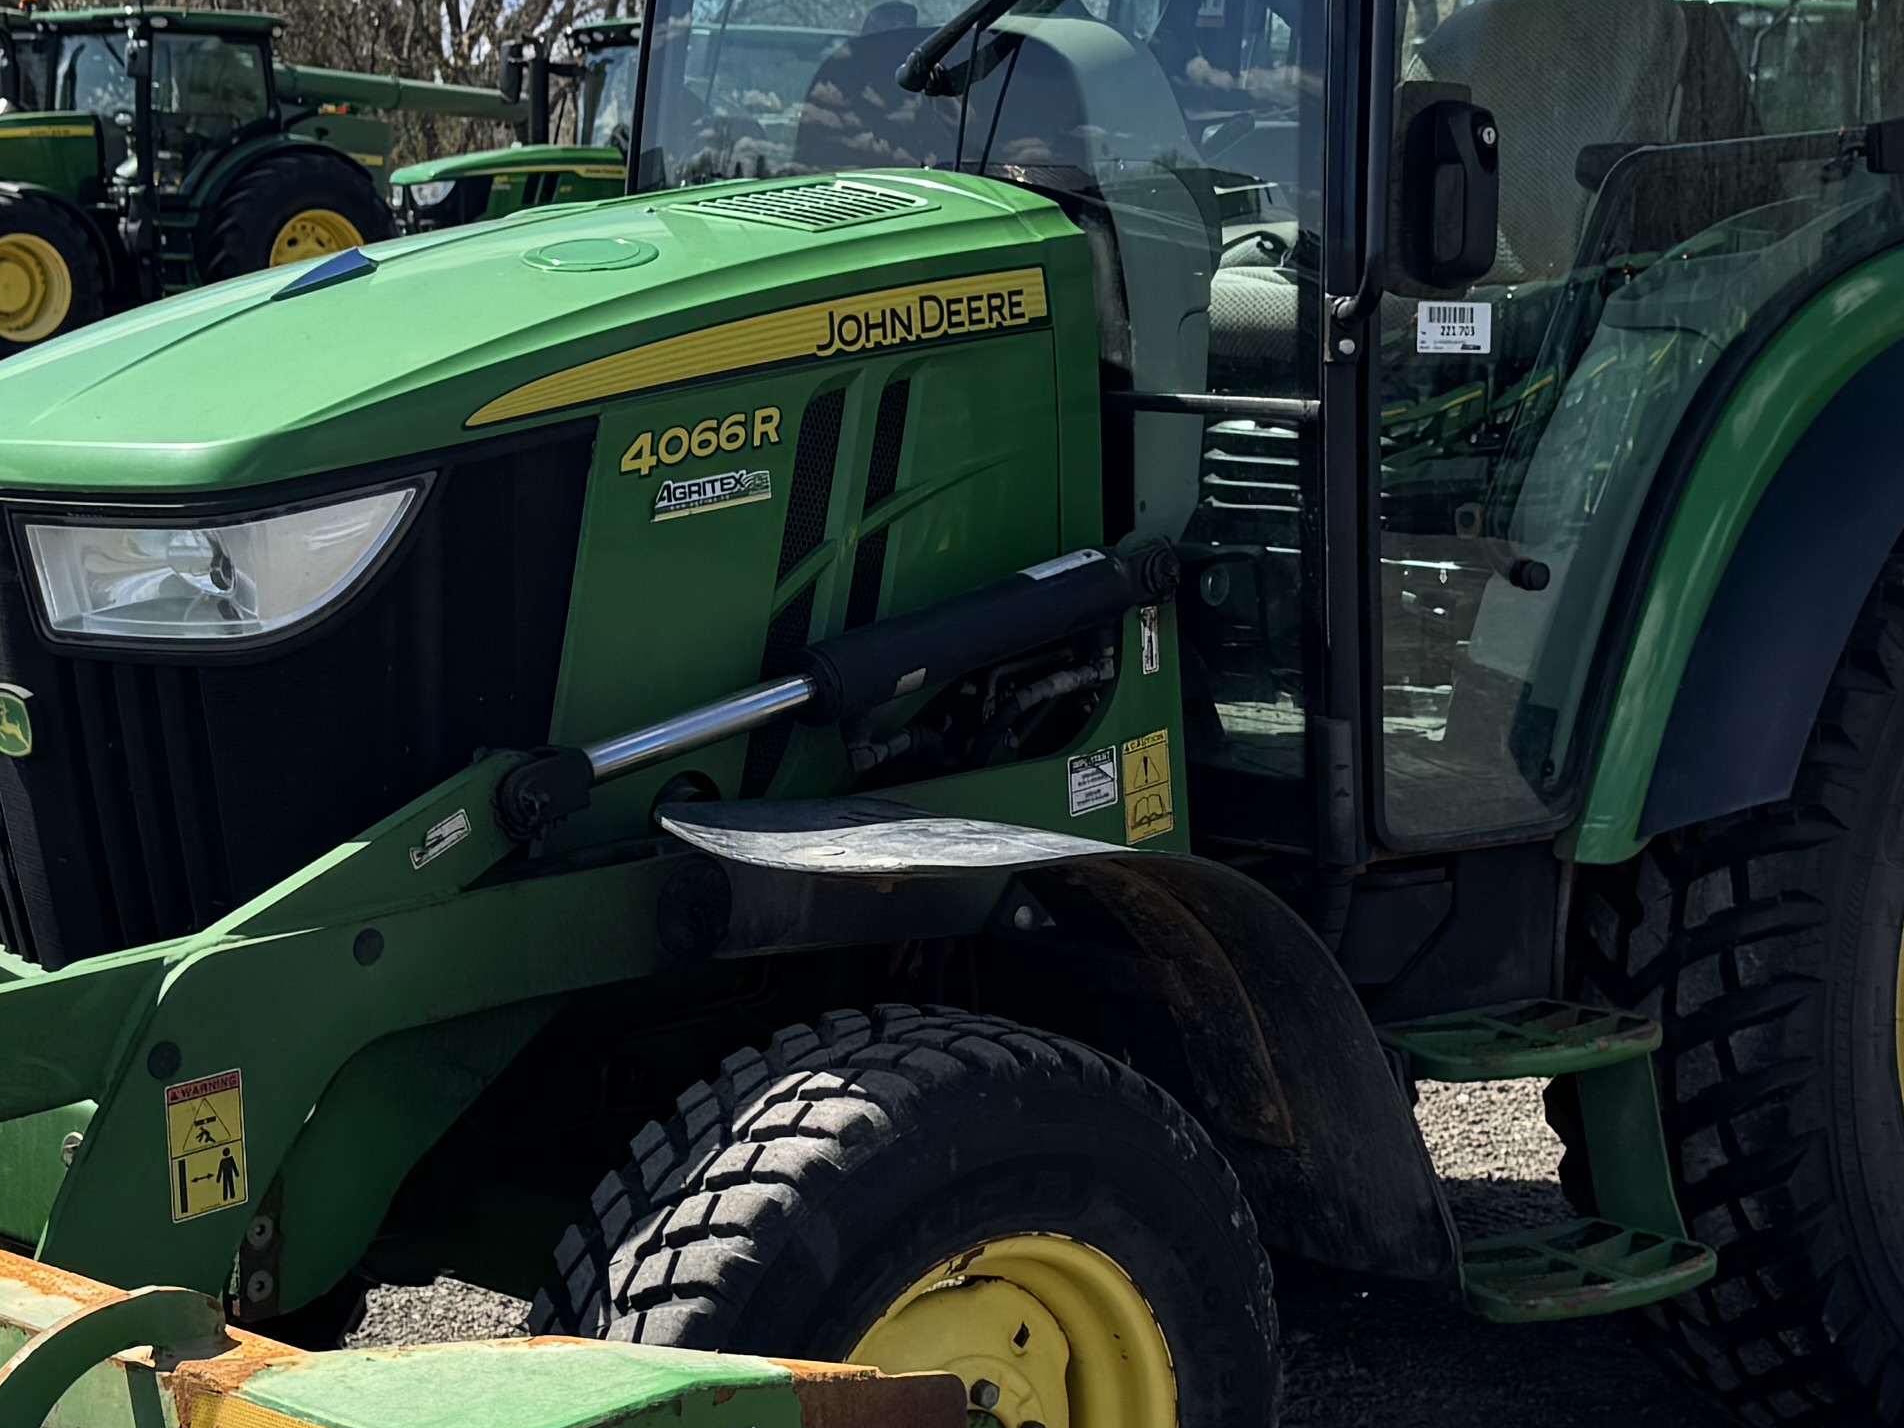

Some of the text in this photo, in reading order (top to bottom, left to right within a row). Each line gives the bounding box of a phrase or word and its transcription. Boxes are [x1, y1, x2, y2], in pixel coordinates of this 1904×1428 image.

[815, 288, 1027, 354] JOHN DEERE
[656, 472, 746, 504] AGRITEX
[181, 1074, 238, 1099] WARNING
